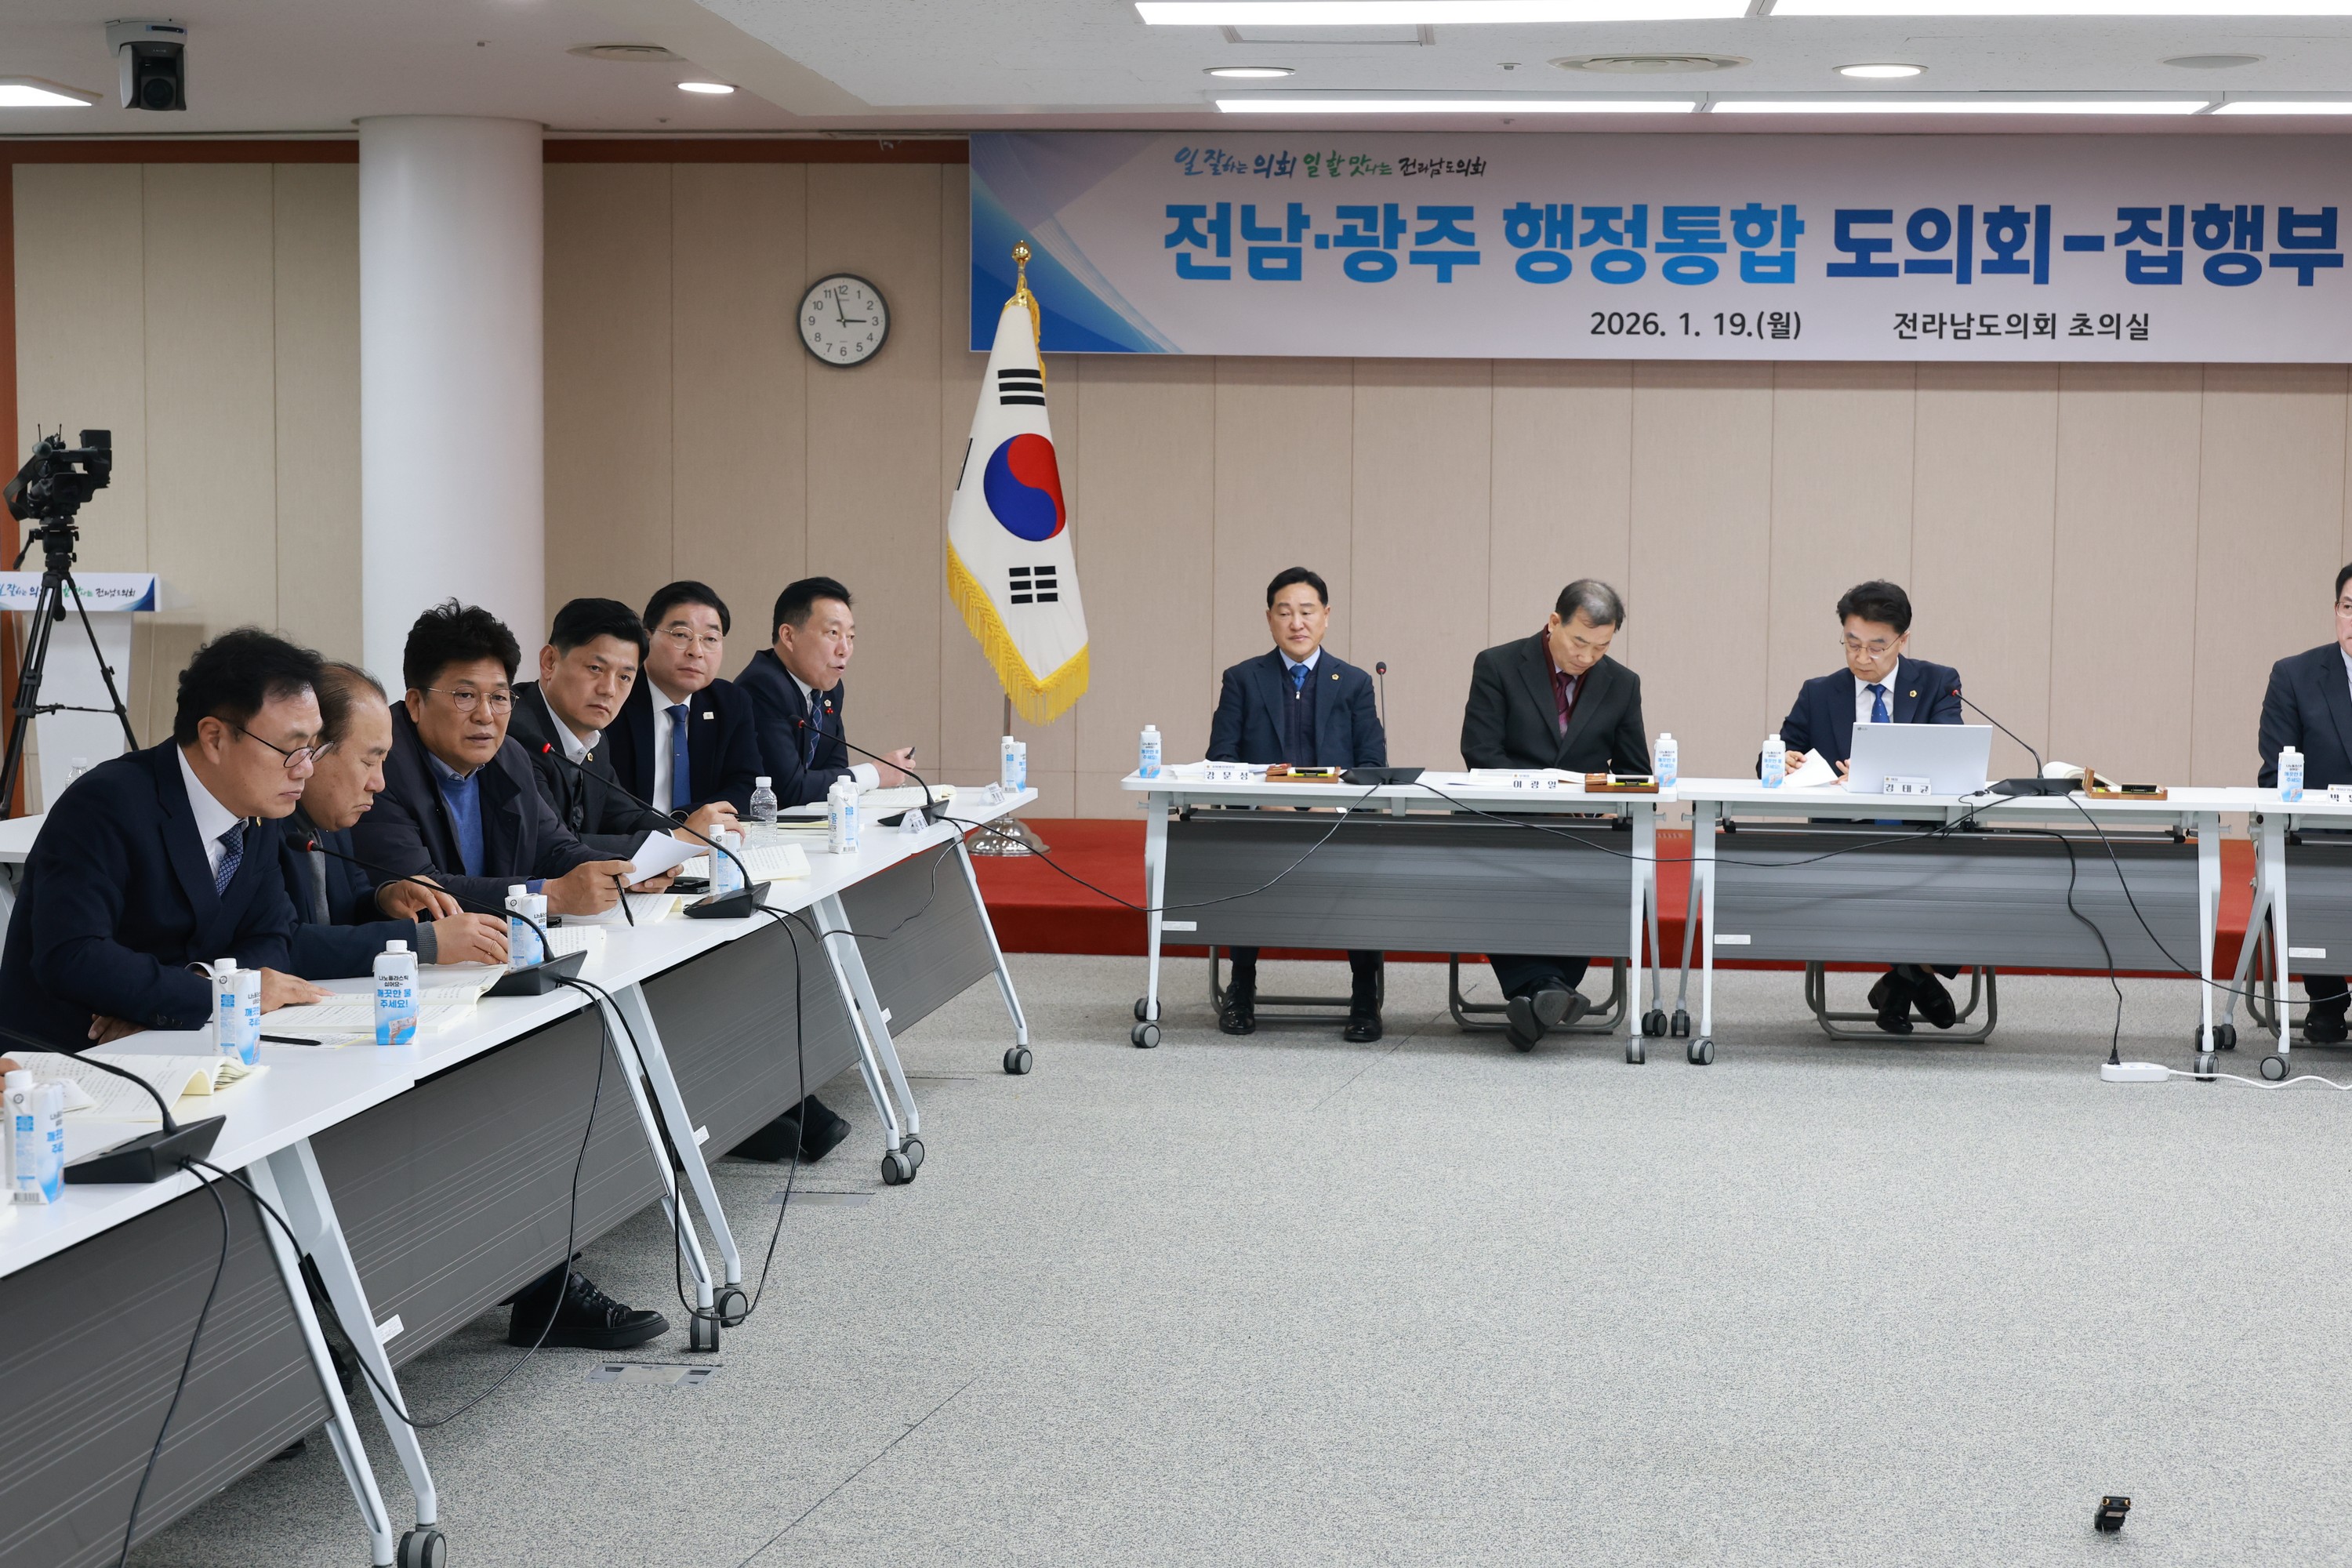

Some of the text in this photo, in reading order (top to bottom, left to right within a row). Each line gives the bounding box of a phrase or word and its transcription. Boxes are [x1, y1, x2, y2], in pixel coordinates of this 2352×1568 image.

[1254, 150, 1297, 178] 의회
[1399, 156, 1487, 179] 전라남도의회
[1165, 202, 1480, 283] 전남·광주
[1504, 202, 1805, 285] 행정통합
[823, 289, 831, 299] 11
[837, 285, 848, 295] 12
[812, 300, 823, 310] 10
[866, 300, 873, 310] 2
[808, 316, 815, 326] 9
[872, 316, 879, 326] 3
[1590, 310, 1802, 340] 2026. 1. 19.(월)
[1893, 312, 2149, 341] 전라남도의회 초의실
[814, 332, 822, 343] 8
[866, 332, 873, 342] 4
[826, 343, 833, 353] 7
[840, 347, 847, 357] 6
[855, 342, 863, 352] 5
[376, 988, 412, 998] 깨끗한 물
[379, 999, 408, 1008] 주세요!
